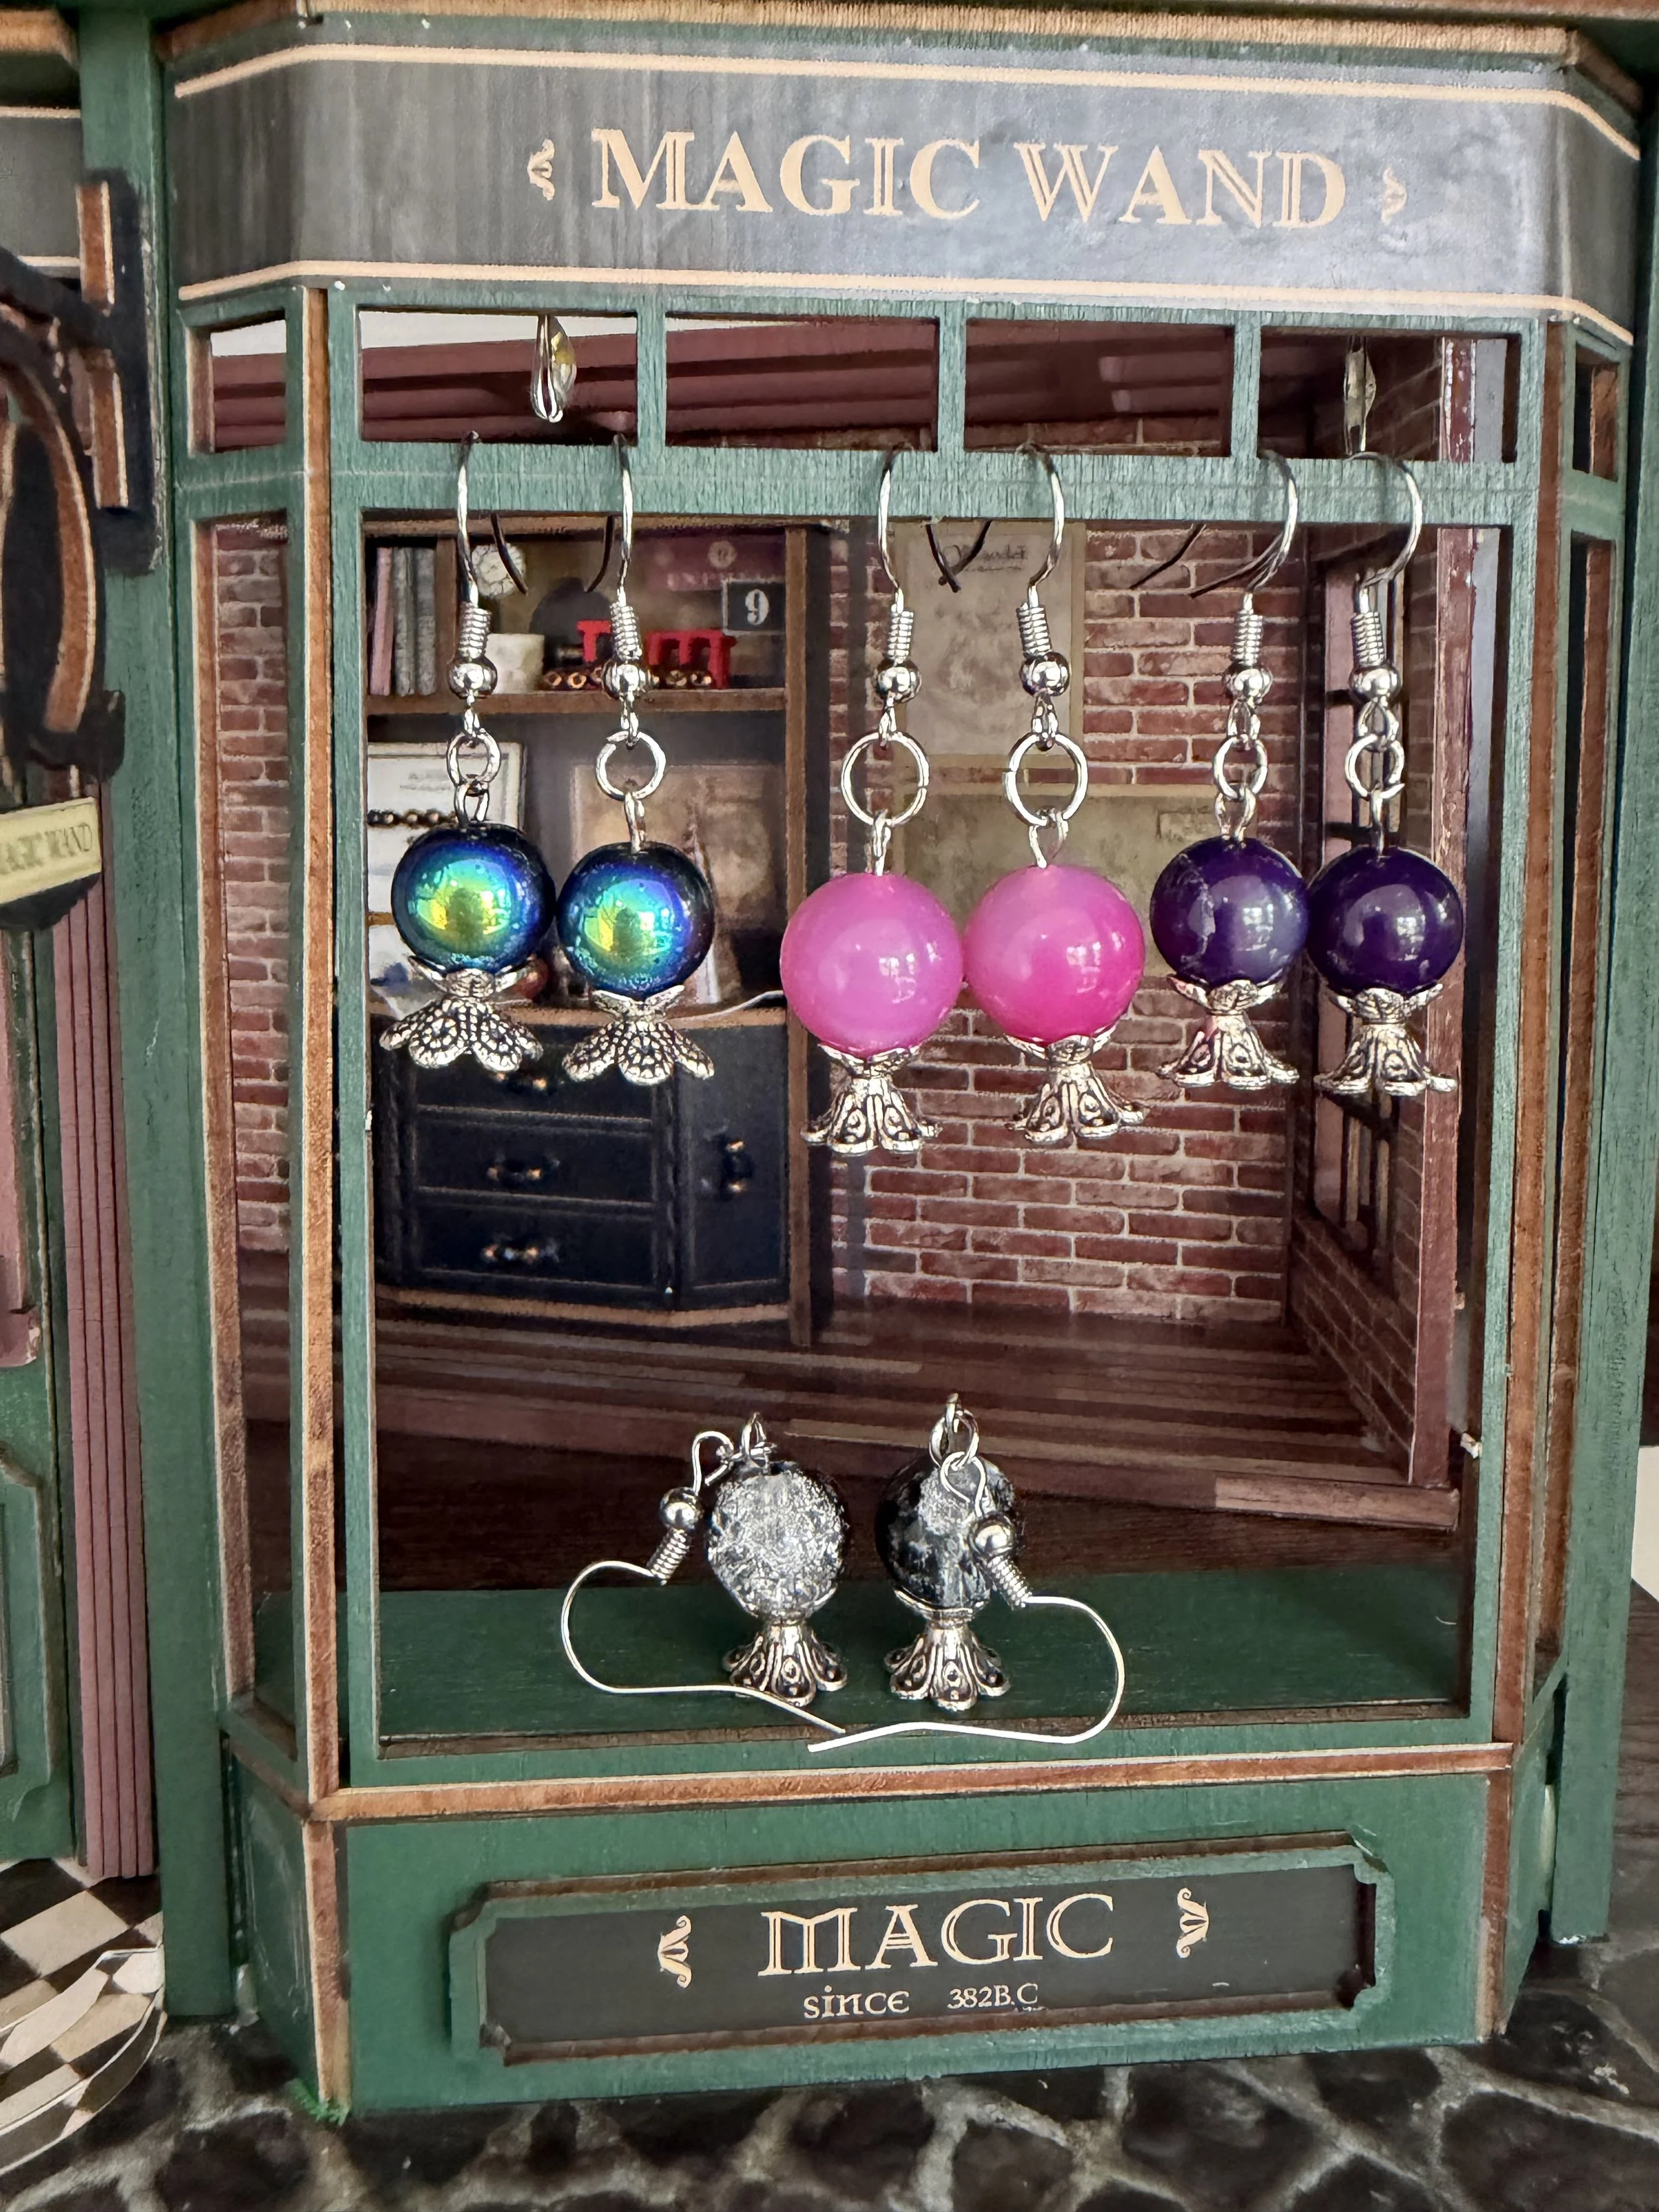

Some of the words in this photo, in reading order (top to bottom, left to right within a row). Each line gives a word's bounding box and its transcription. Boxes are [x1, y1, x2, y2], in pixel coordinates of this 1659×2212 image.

[591, 129, 981, 216] MAGIC
[1015, 142, 1346, 227] WAND
[745, 589, 769, 625] 9
[758, 1893, 1114, 1976] MAGIC
[804, 1984, 910, 2019] since
